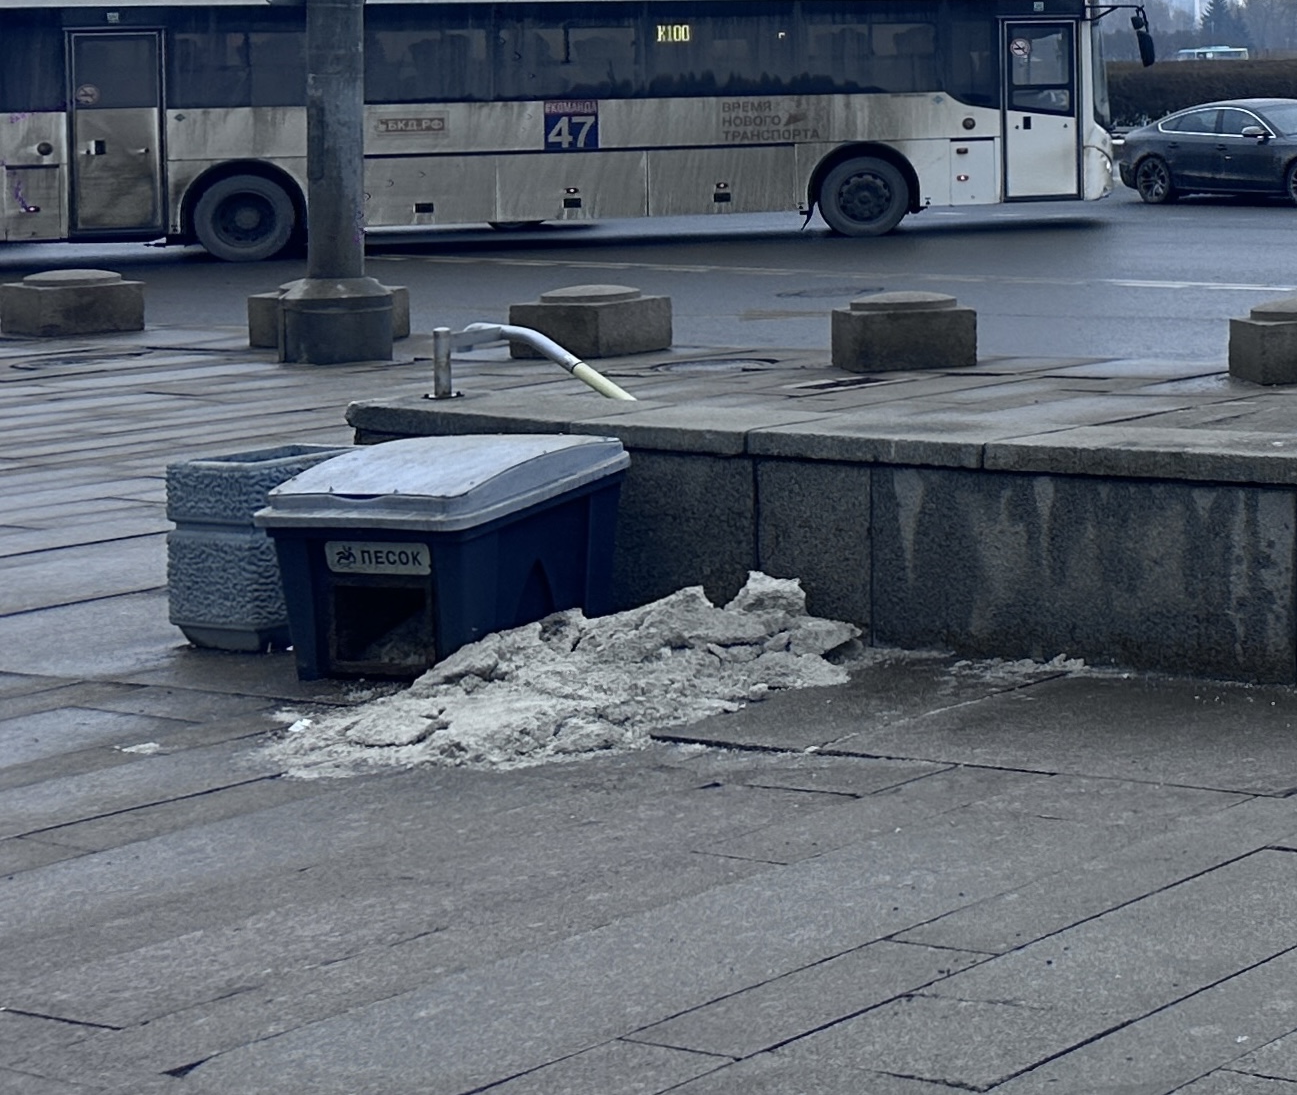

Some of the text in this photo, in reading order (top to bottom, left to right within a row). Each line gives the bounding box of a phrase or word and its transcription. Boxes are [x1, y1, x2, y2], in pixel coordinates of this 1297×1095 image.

[721, 100, 773, 113] ВРЕМЯ
[387, 119, 444, 131] БКД.РФ
[721, 114, 782, 128] НОВОГО
[547, 115, 596, 148] 47
[722, 128, 820, 142] ТРАНСПОРТА
[361, 550, 422, 566] ПЕСОК
